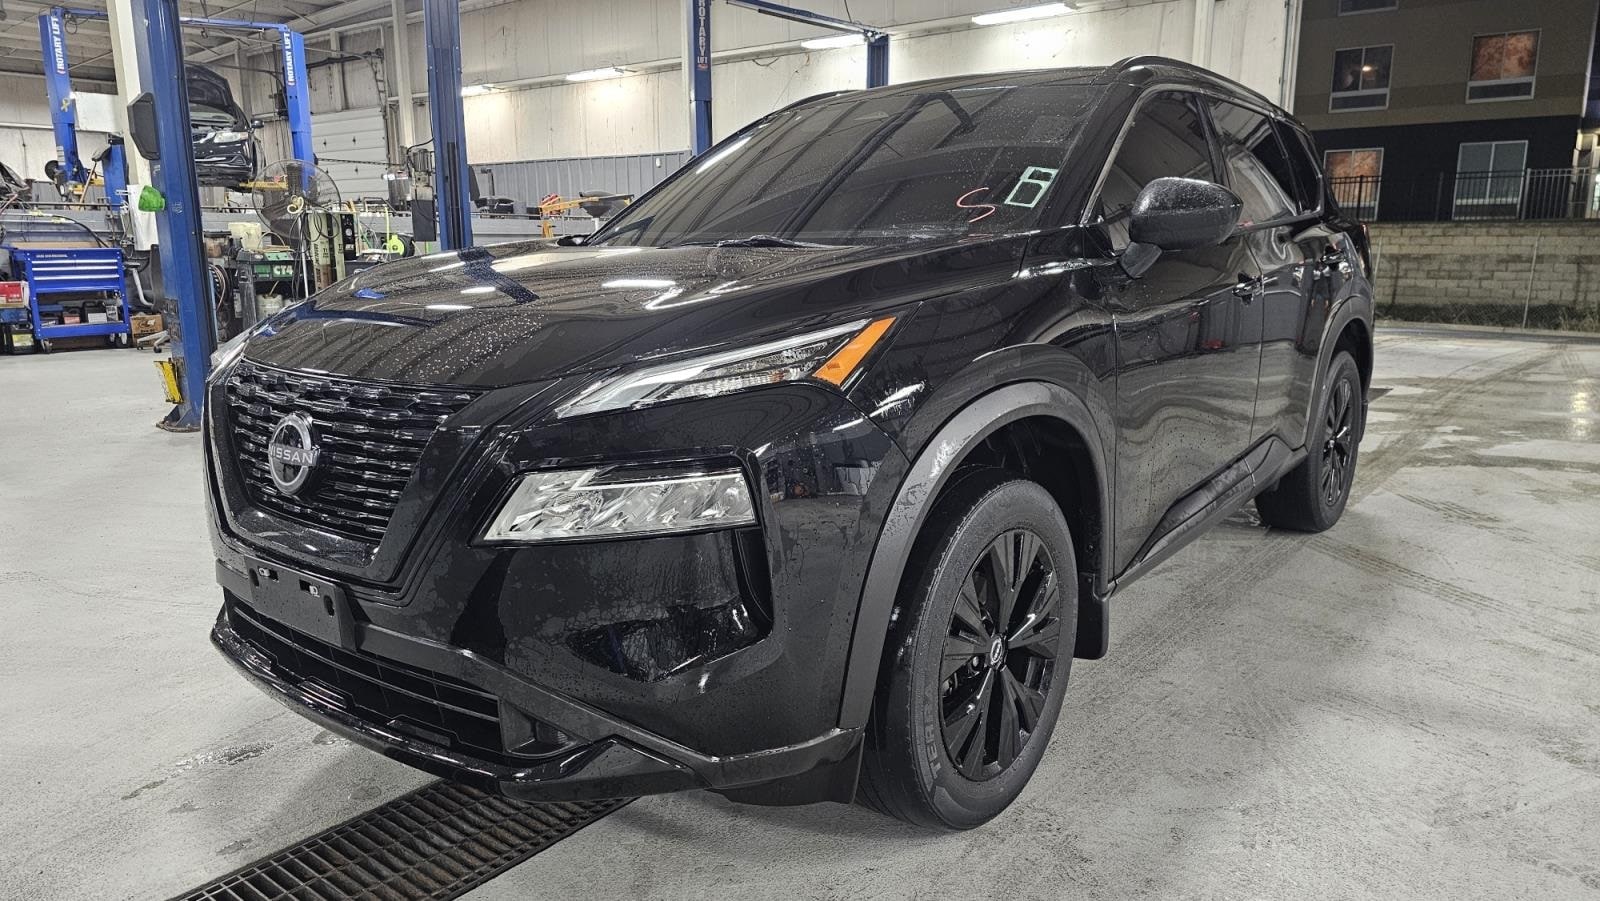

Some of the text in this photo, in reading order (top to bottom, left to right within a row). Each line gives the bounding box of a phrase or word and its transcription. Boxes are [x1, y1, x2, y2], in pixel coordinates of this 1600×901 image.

[51, 16, 65, 69] ROTARY LIFT
[698, 0, 706, 56] ROTARY
[285, 50, 295, 81] ROTARY
[270, 445, 313, 464] NISSAN
